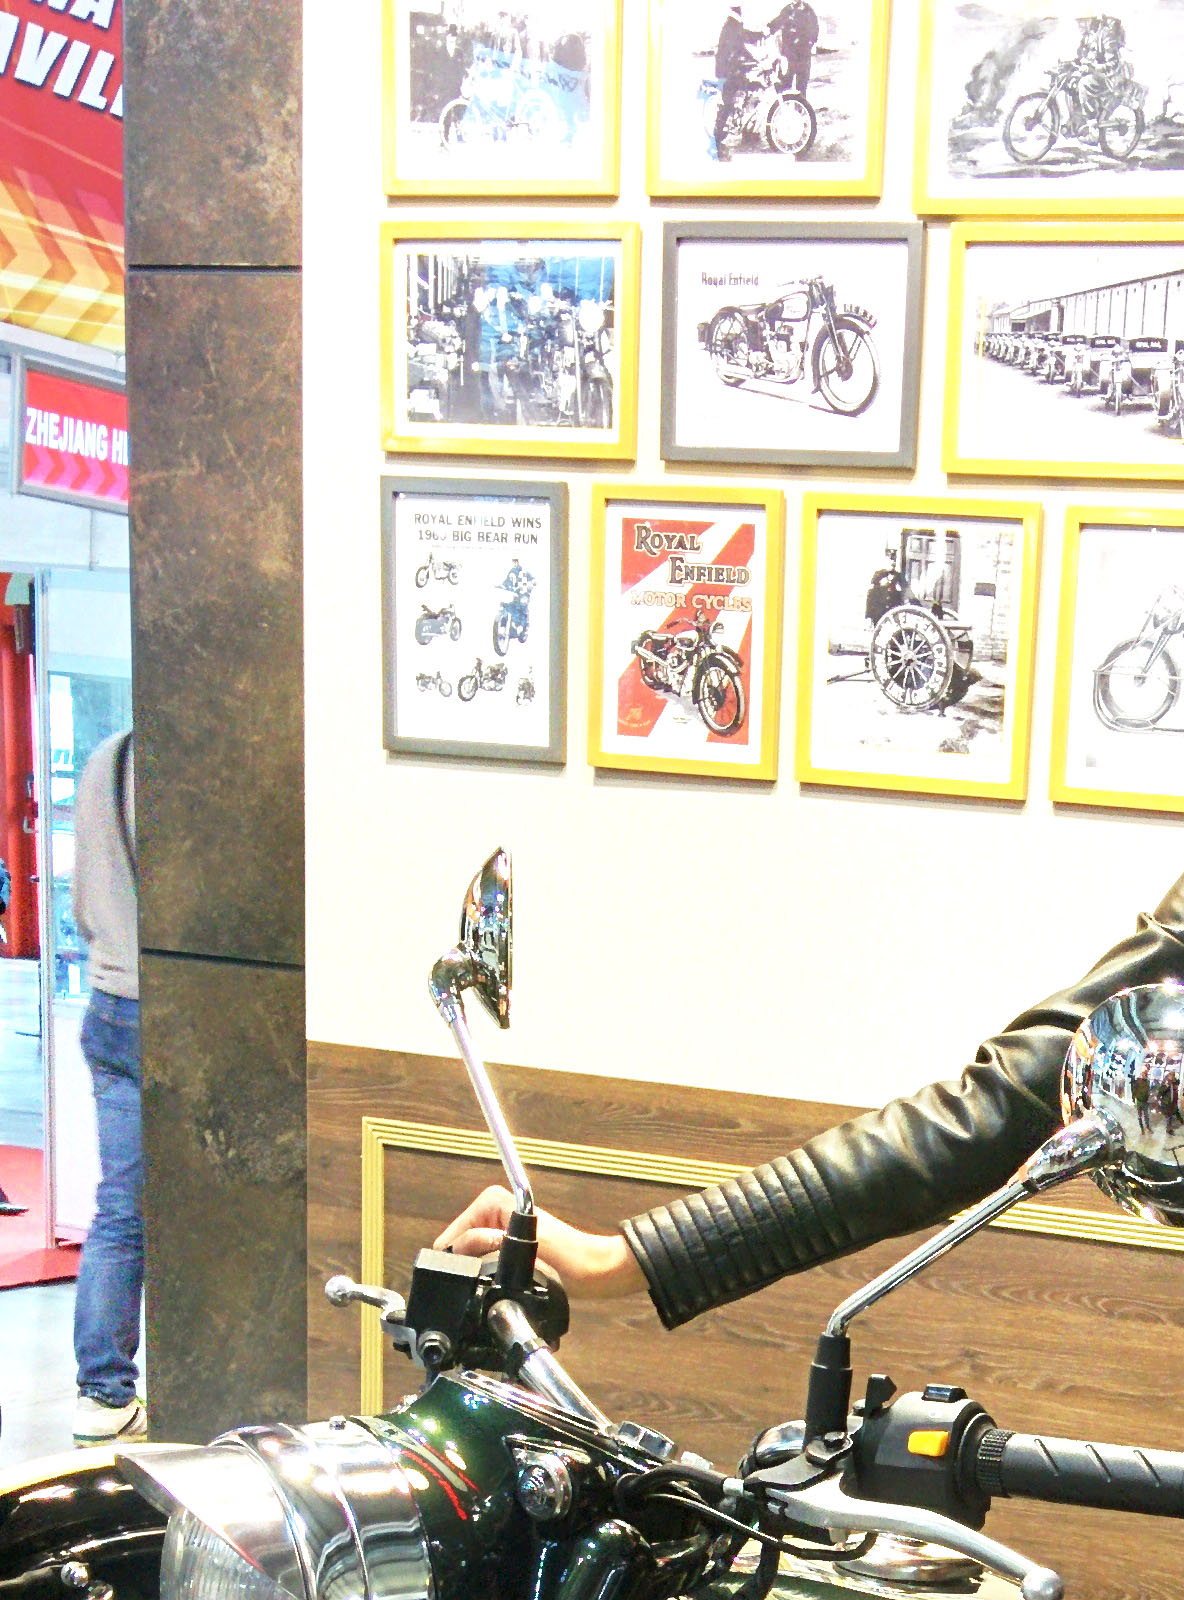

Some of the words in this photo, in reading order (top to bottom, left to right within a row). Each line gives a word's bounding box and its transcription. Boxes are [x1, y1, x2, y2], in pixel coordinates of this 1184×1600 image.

[25, 406, 108, 461] ZHEJIANG
[414, 513, 452, 526] ROYAL
[511, 517, 542, 529] WINS
[452, 531, 472, 542] BIG
[477, 532, 508, 544] BEAR
[514, 533, 538, 544] RUN
[631, 590, 687, 608] MOTOR
[692, 594, 753, 612] CYCLES
